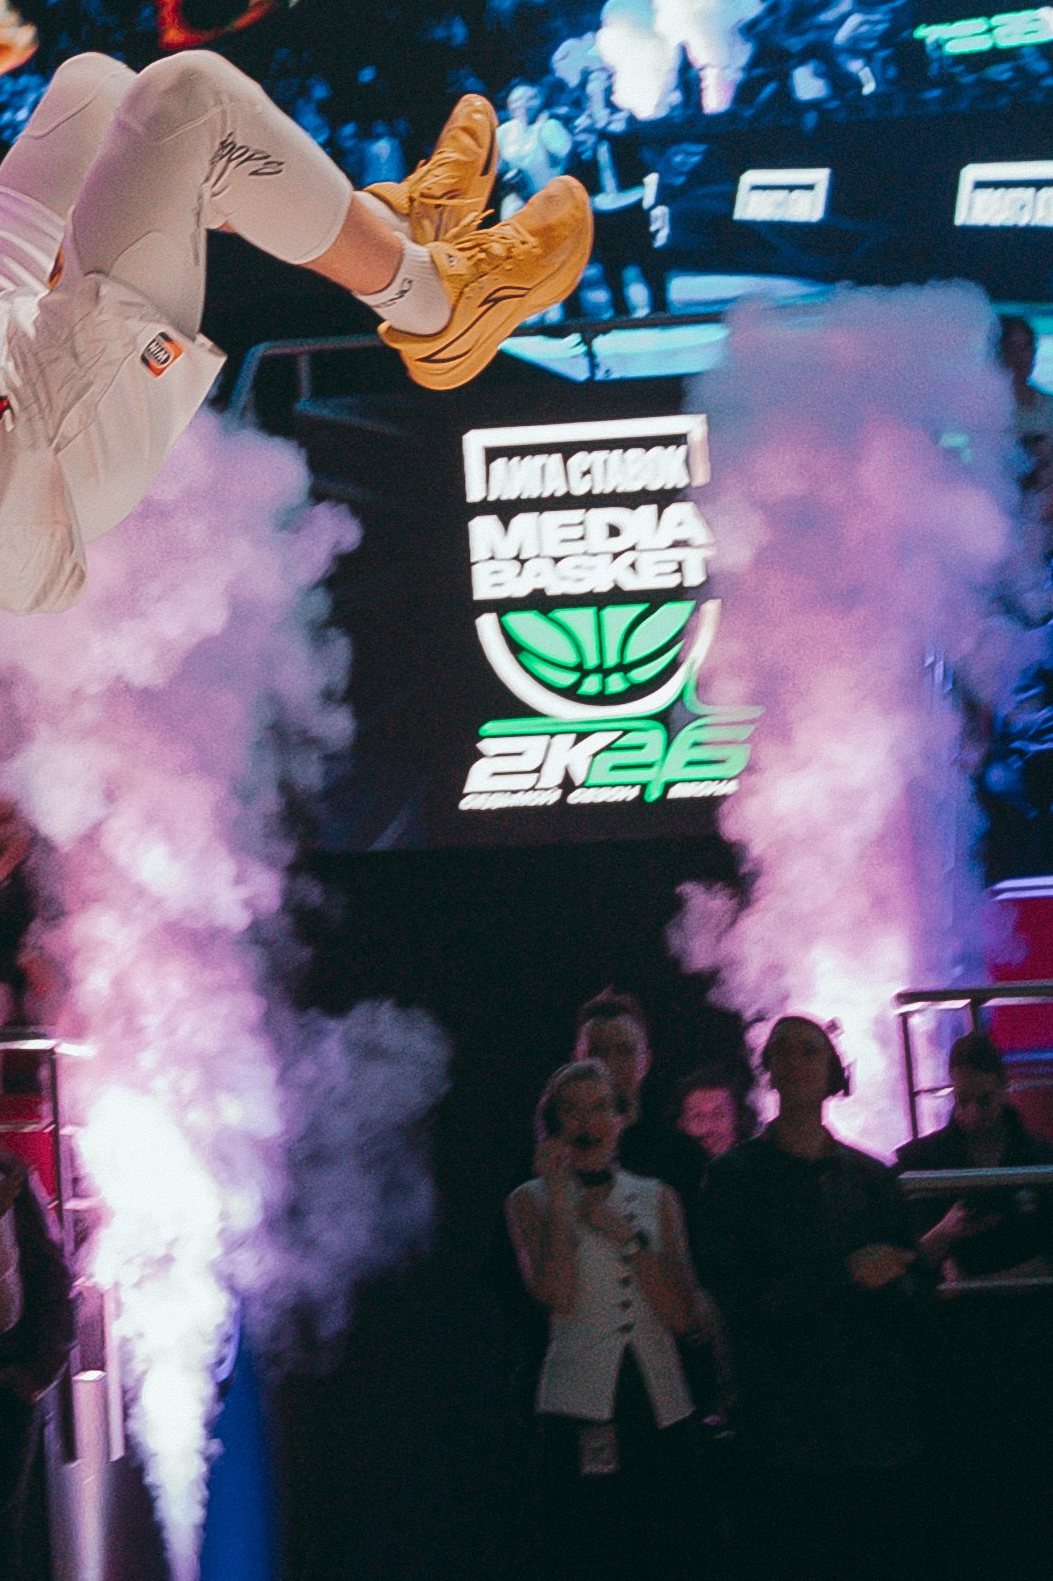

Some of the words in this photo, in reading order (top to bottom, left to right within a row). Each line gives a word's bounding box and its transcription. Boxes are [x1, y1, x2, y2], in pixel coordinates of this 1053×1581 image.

[467, 501, 714, 563] MEDIA
[471, 546, 716, 600] BASKET
[462, 716, 760, 802] 2K26
